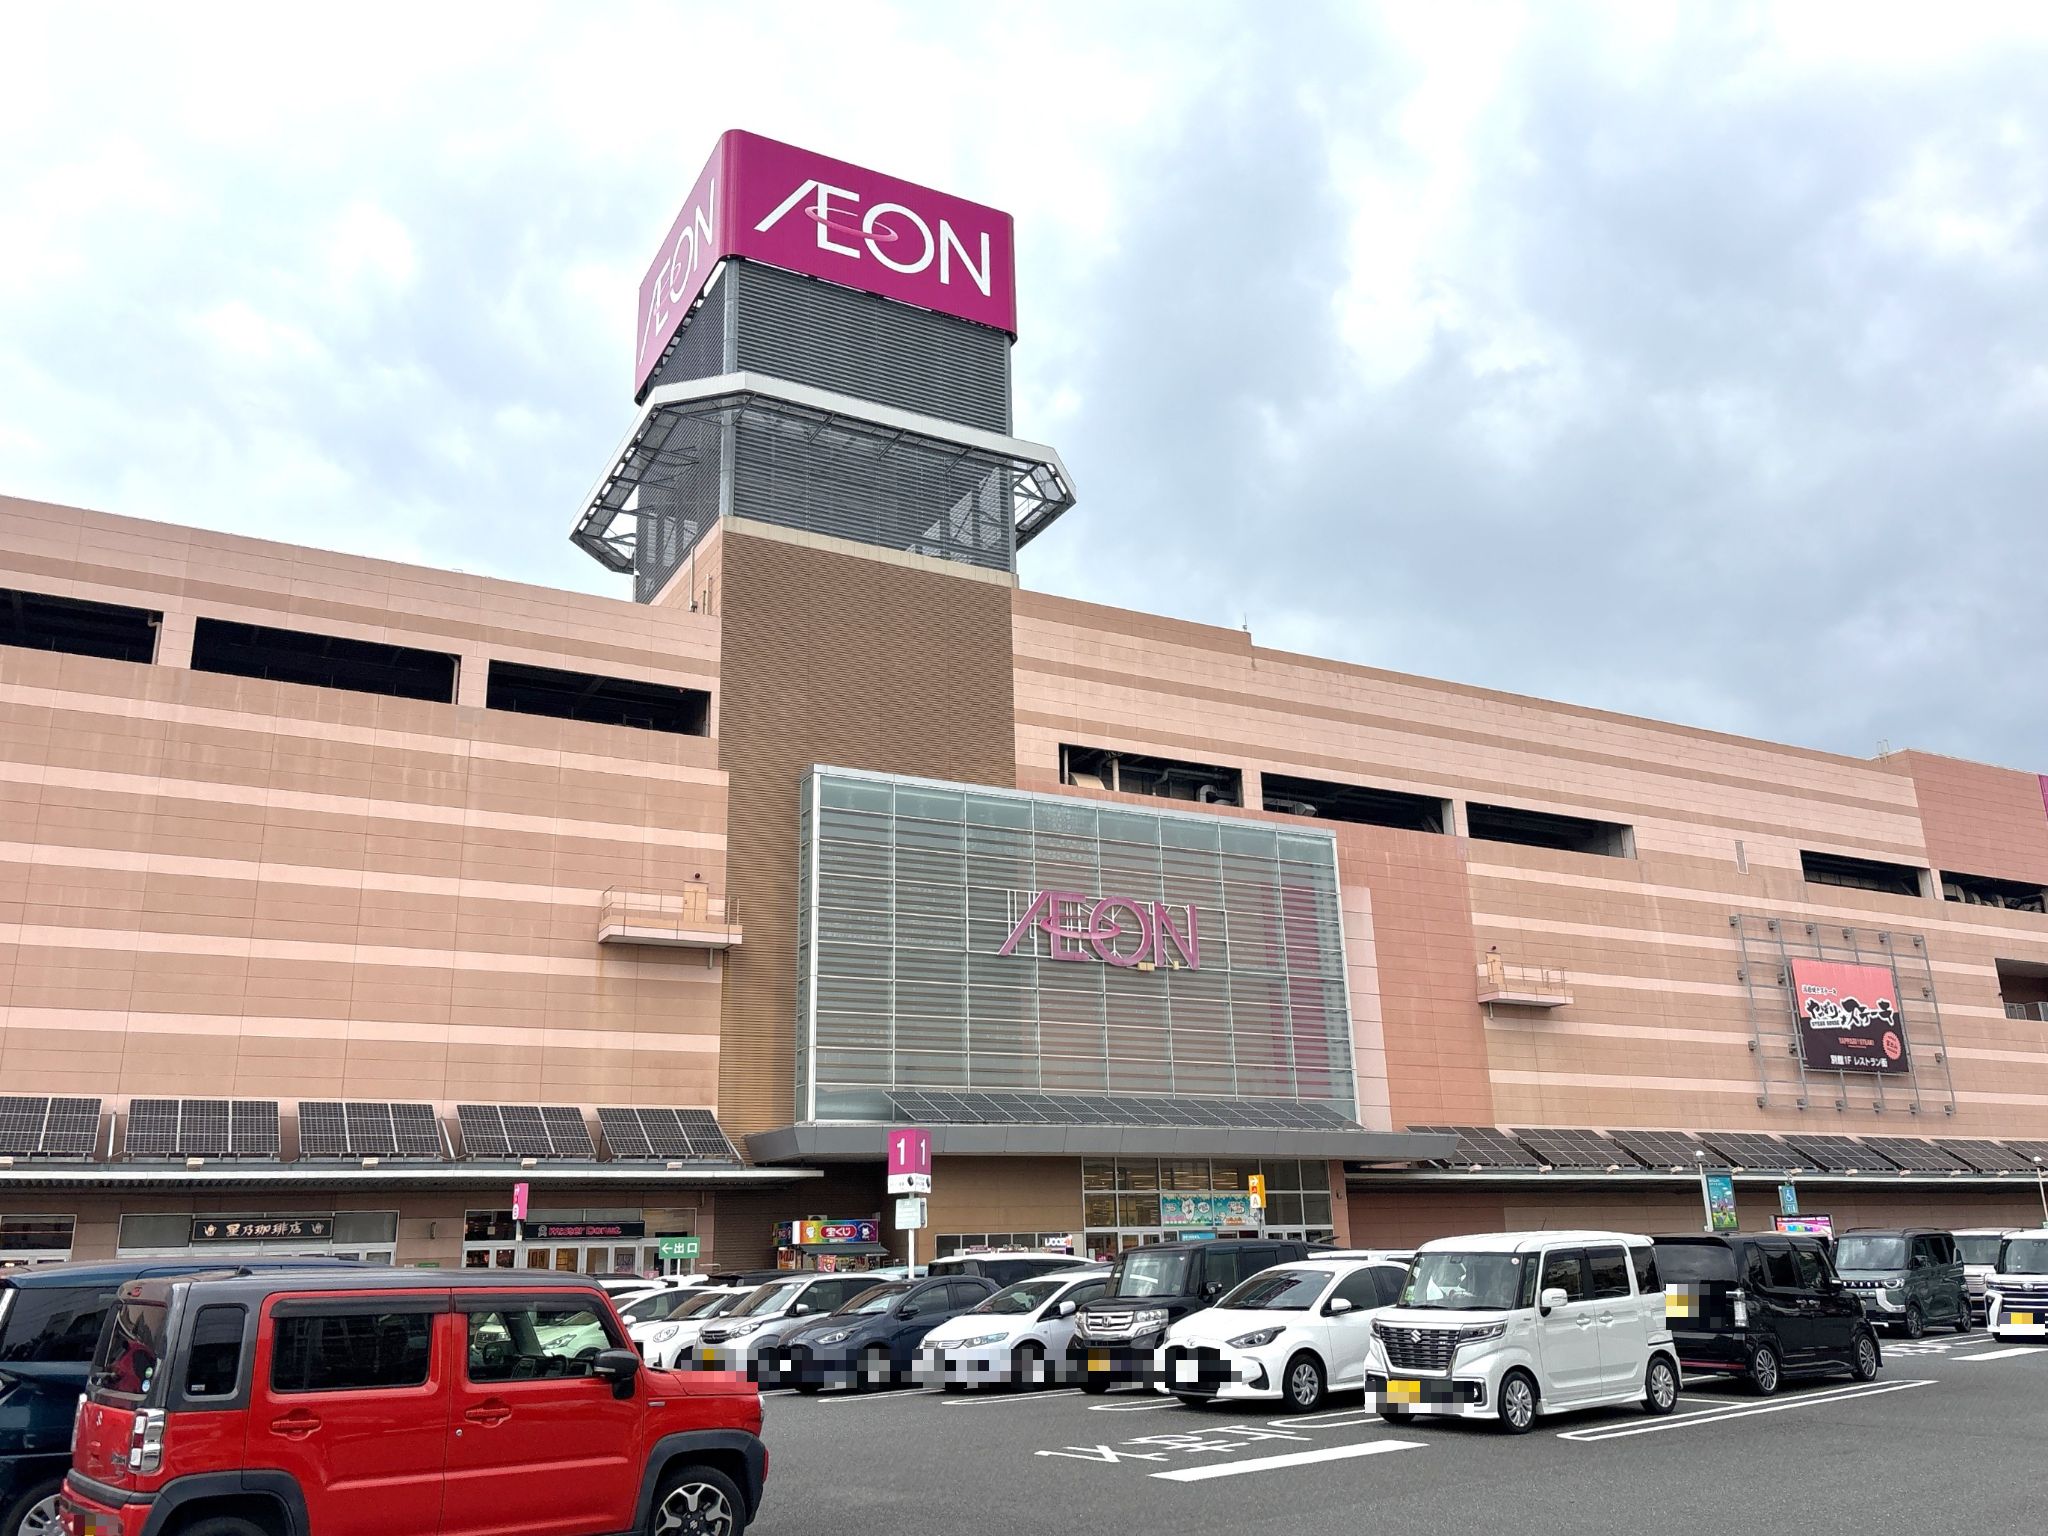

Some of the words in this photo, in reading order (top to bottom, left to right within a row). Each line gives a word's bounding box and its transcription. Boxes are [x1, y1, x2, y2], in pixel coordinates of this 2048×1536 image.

[896, 1137, 905, 1166] 1
[920, 1138, 926, 1166] 1
[225, 1221, 304, 1237] 星乃珈琲店
[825, 1227, 852, 1237] 宝くじ
[673, 1241, 698, 1254] 出口
